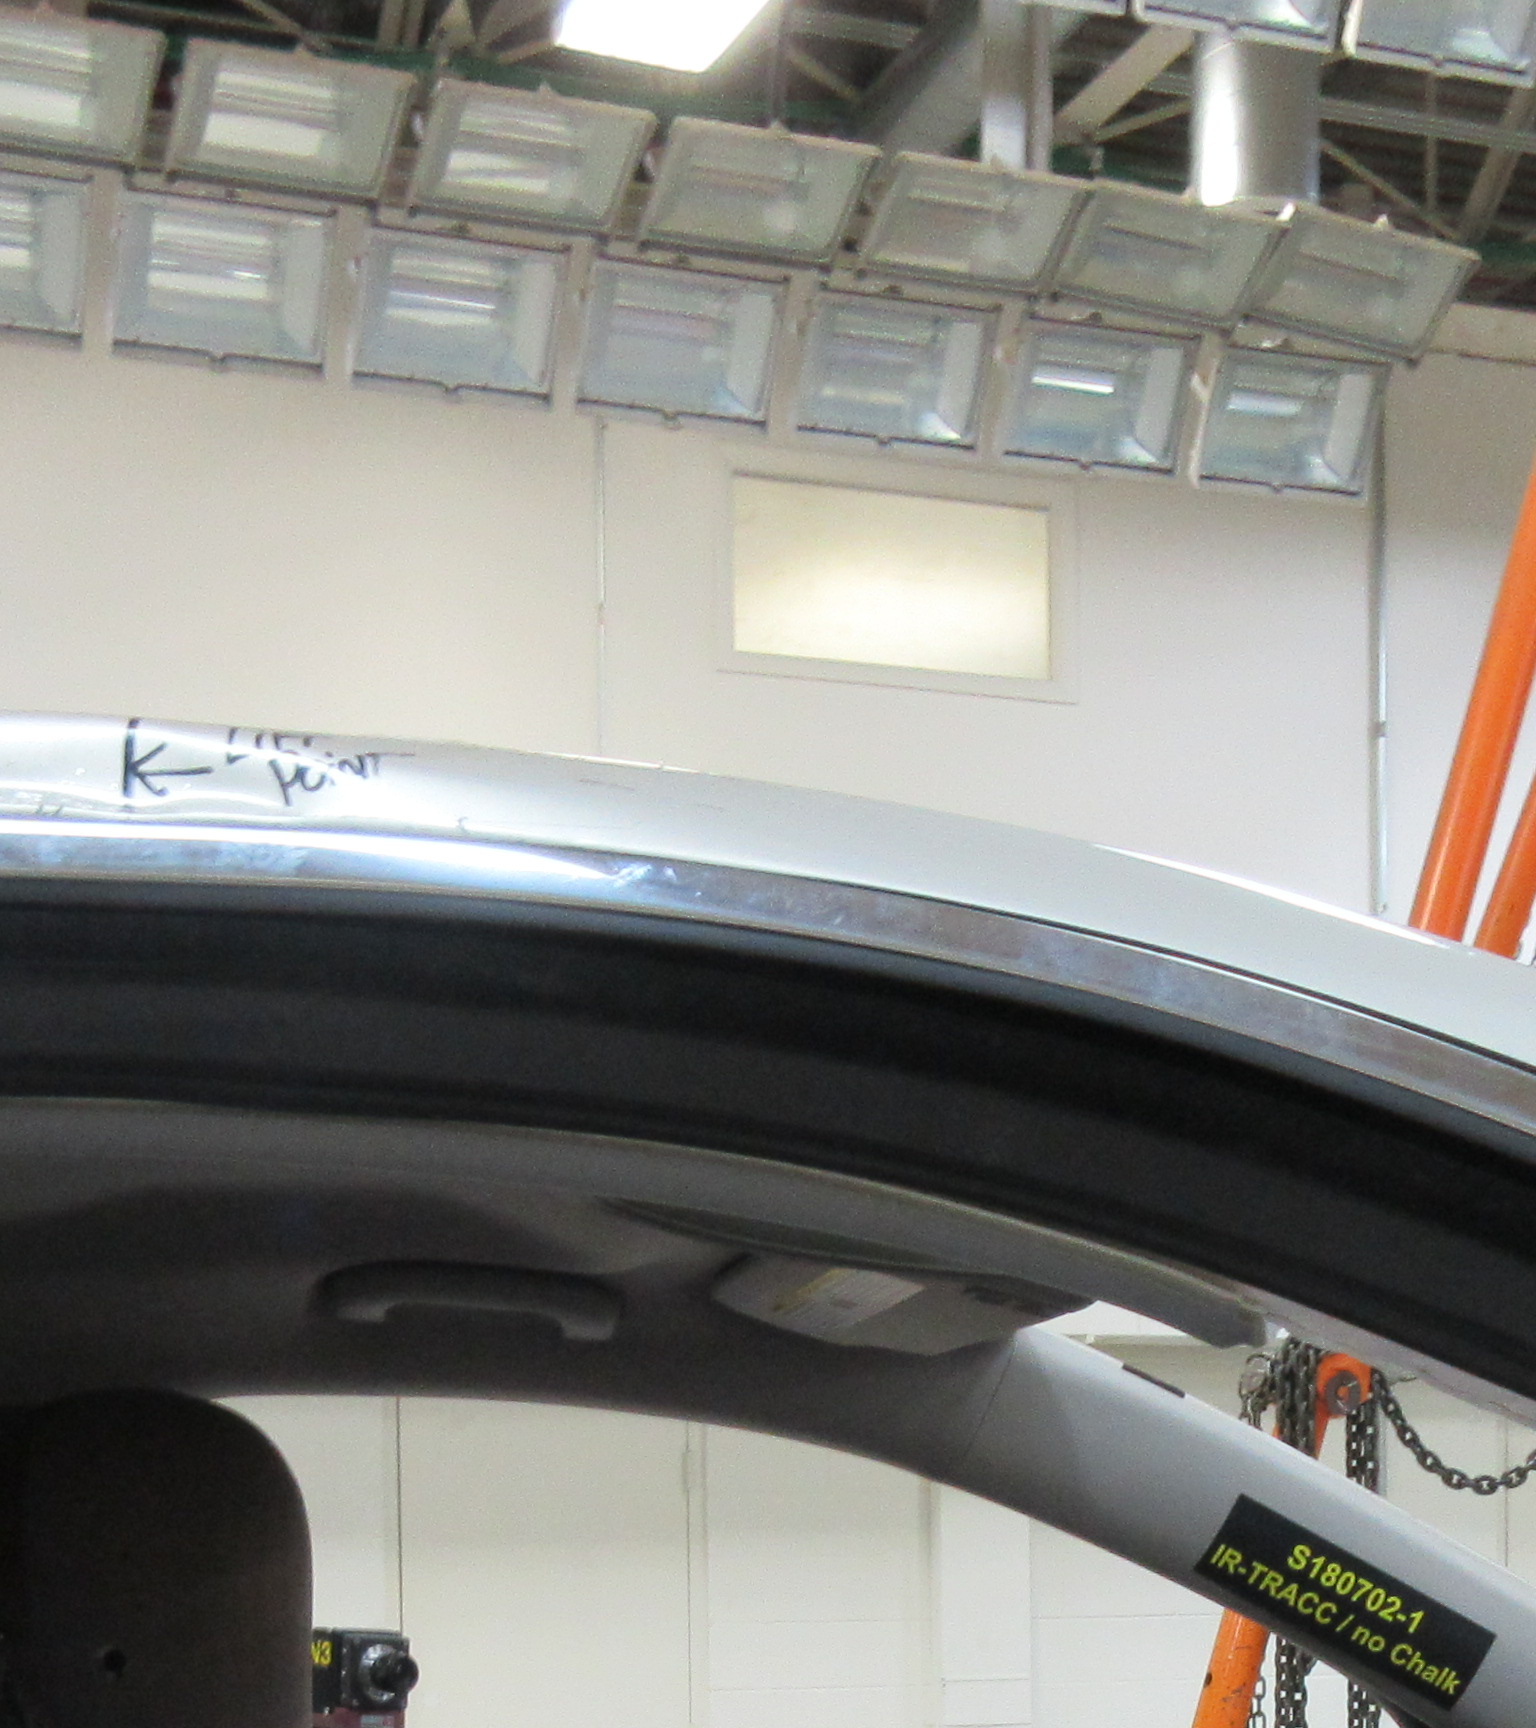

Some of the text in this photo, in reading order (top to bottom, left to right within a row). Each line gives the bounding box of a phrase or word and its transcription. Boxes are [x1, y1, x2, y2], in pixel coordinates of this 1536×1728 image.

[1210, 1543, 1461, 1696] IR-TRACC / no Chalk
[1287, 1543, 1424, 1634] S180702-1
